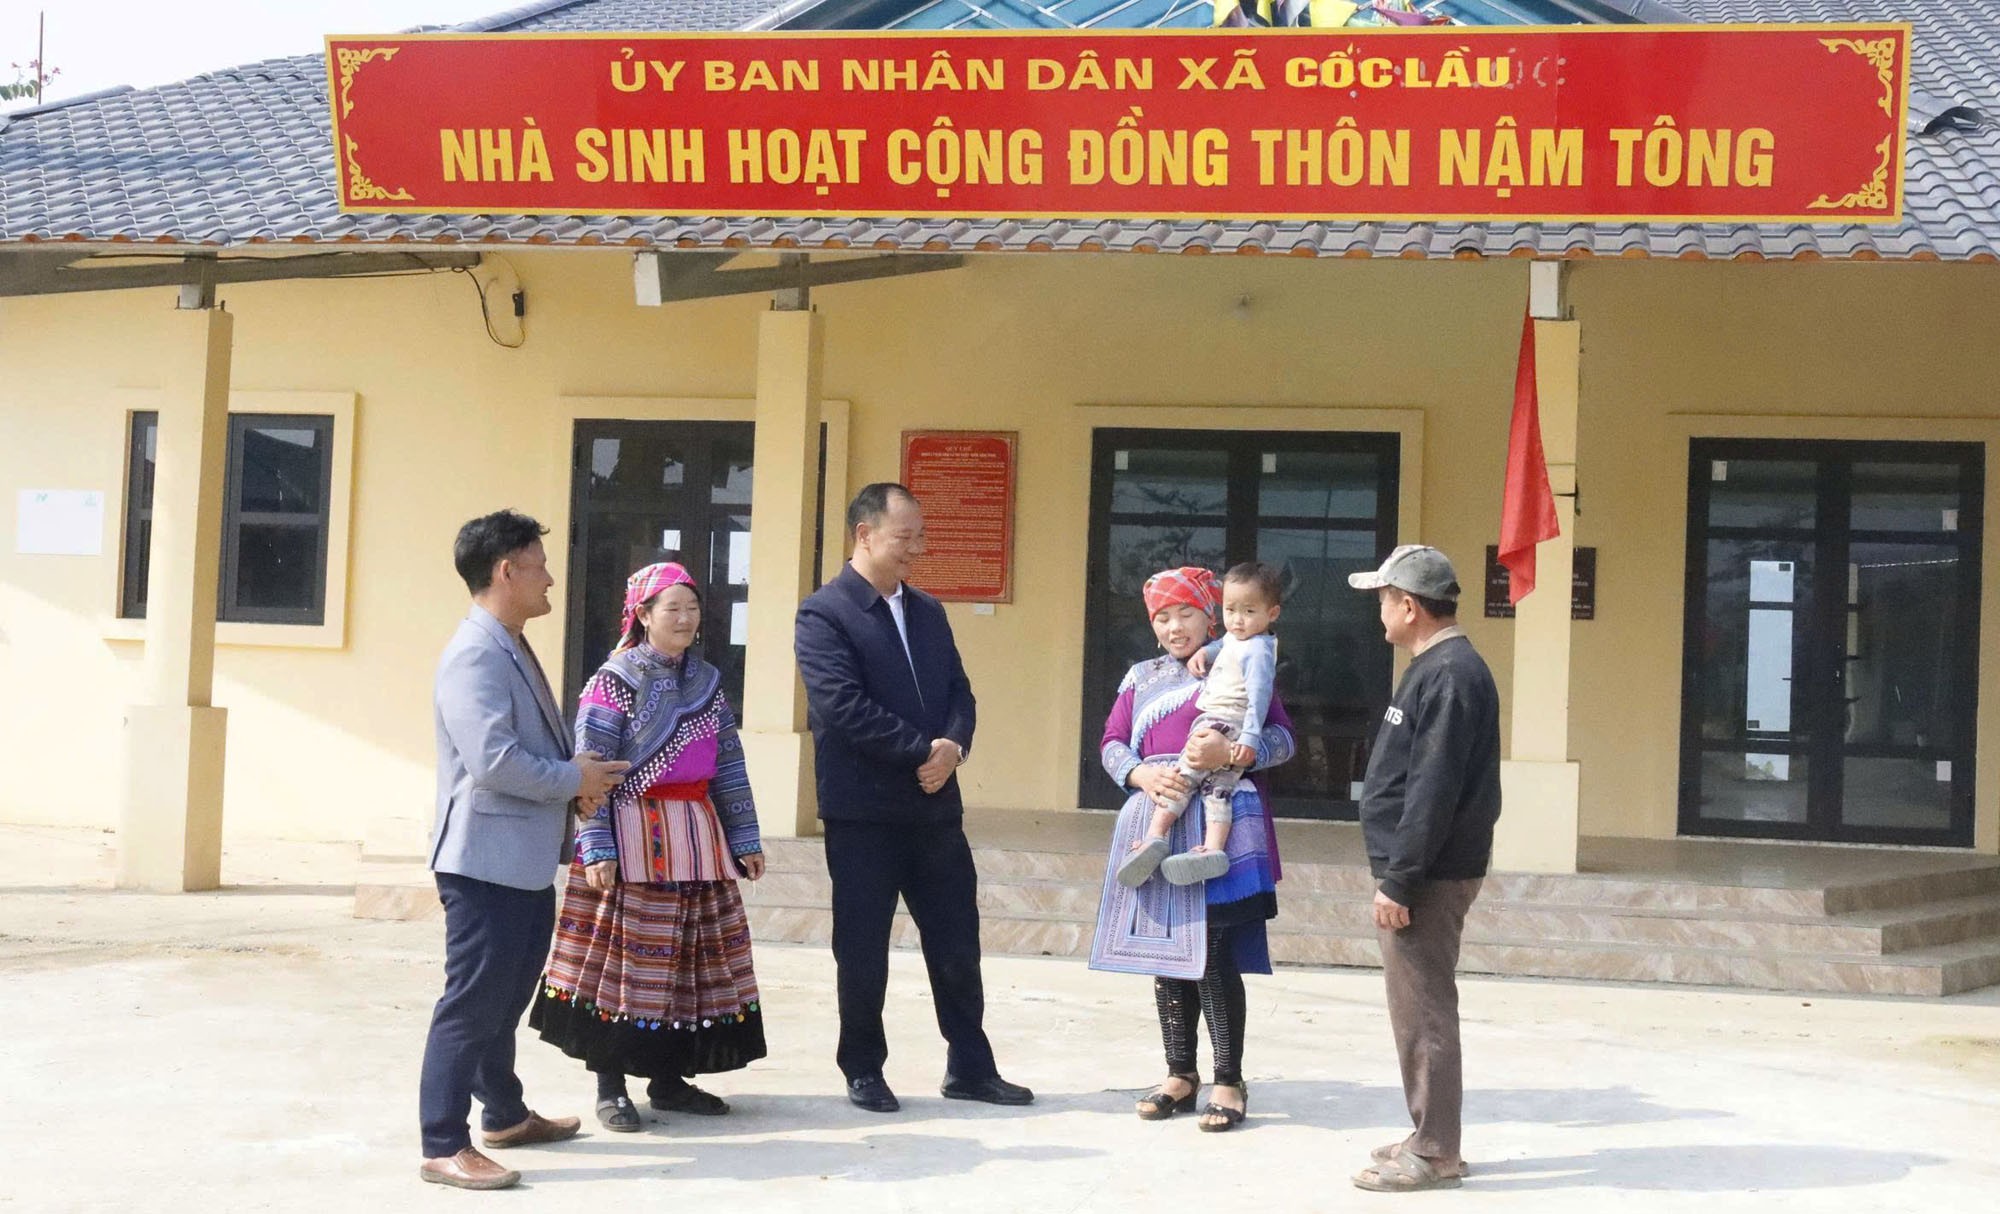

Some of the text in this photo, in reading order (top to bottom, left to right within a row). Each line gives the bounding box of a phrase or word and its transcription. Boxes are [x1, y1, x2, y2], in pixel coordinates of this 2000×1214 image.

[610, 48, 686, 92] ỦY
[704, 59, 820, 92] BAN
[842, 51, 1004, 91] NHÂN
[1027, 50, 1153, 91] DÂN
[1177, 48, 1266, 91] XÃ
[1404, 45, 1511, 89] LẦU
[440, 106, 1775, 198] NHÀ SINH HOẠT CỘNG ĐỒNG THÔN NẬM TÔNG
